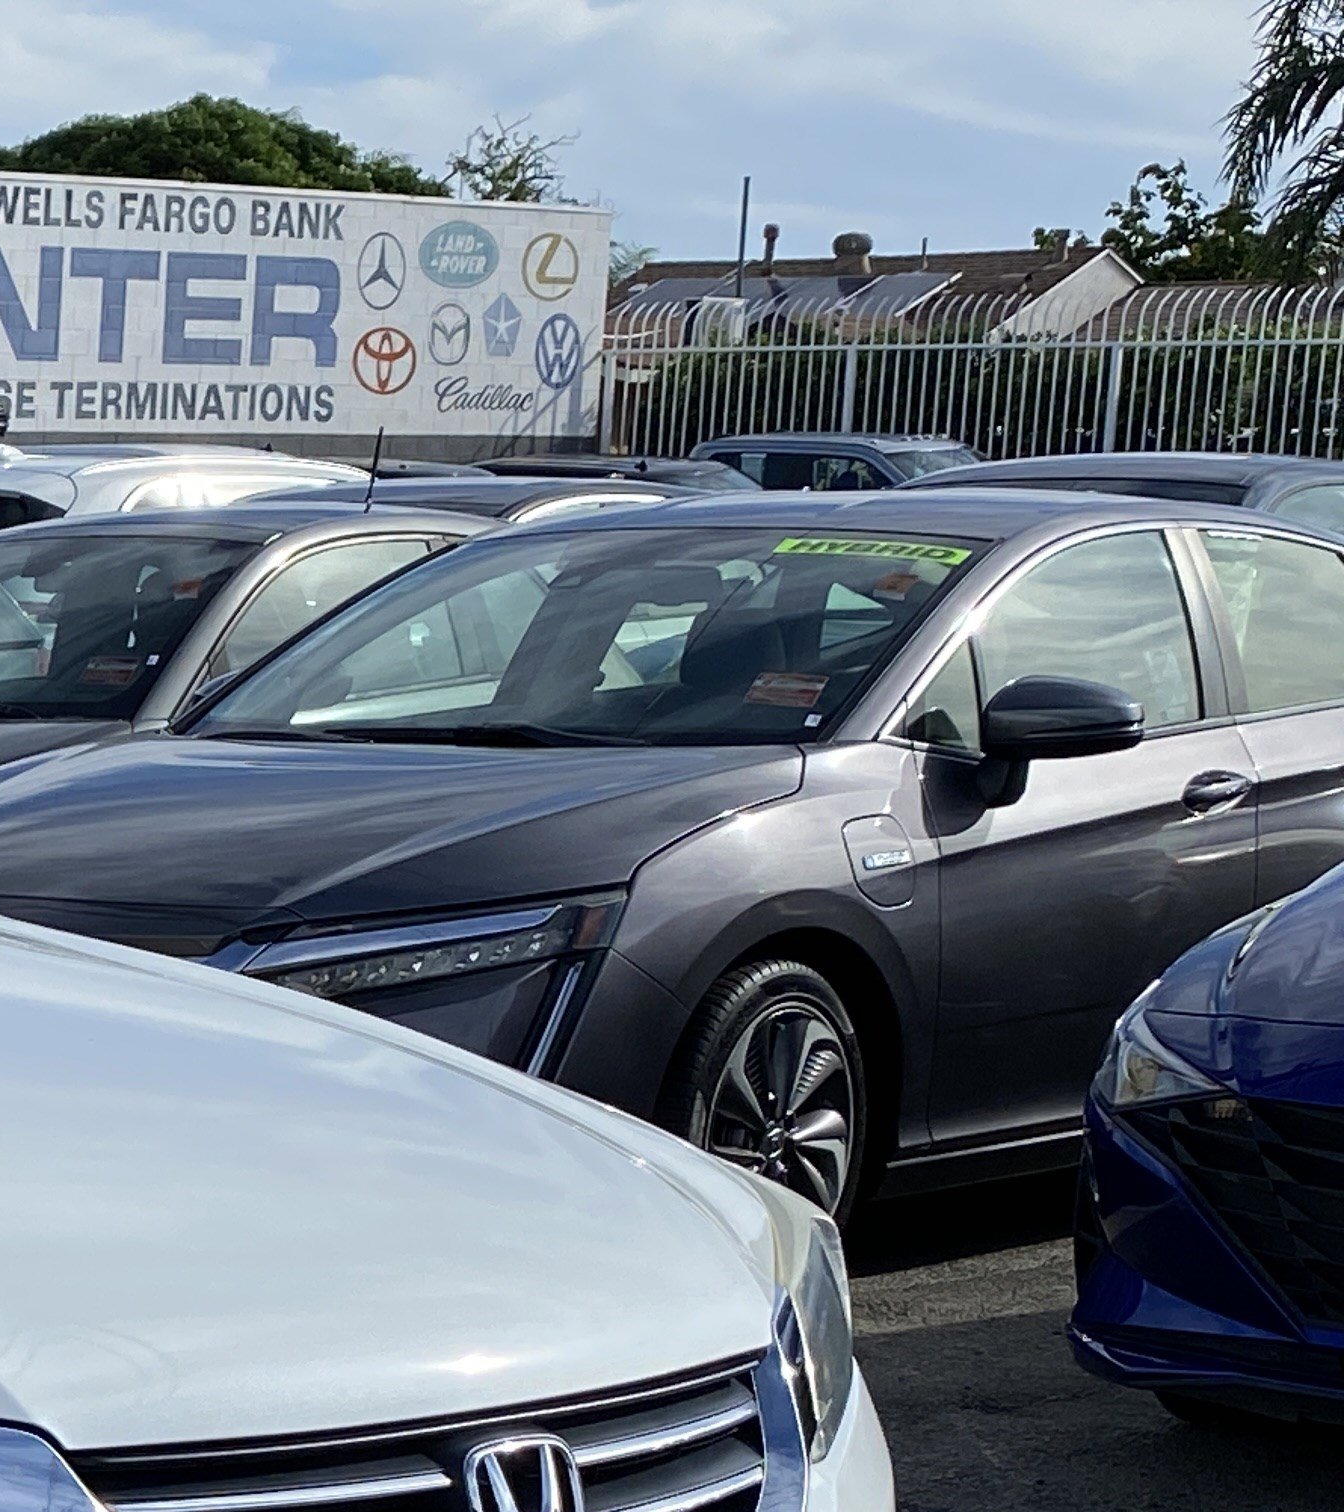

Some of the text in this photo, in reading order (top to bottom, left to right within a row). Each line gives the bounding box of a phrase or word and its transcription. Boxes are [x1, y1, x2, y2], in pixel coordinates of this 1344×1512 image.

[119, 193, 235, 235] FARGO
[250, 201, 345, 240] BANK
[436, 234, 475, 253] LAND
[438, 255, 487, 274] ROVER
[49, 380, 335, 422] TERMINATIONS
[435, 376, 533, 413] Cadillac
[788, 540, 957, 559] HYBRID
